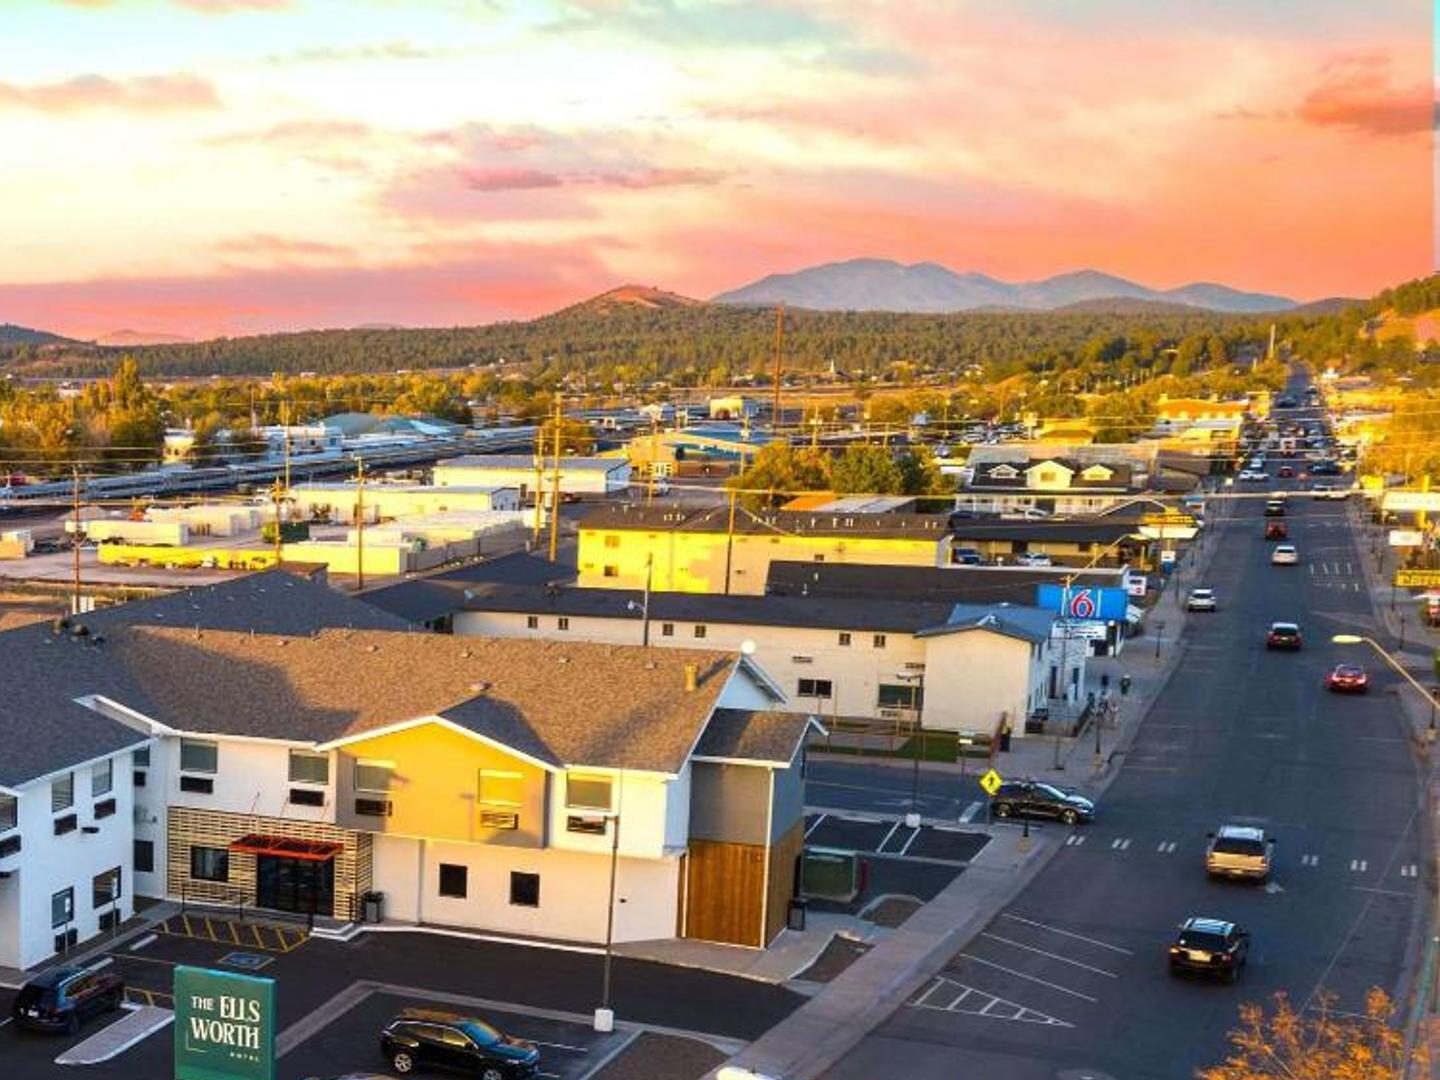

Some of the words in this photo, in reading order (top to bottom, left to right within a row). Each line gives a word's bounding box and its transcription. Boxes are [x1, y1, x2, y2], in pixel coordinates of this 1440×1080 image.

[1071, 589, 1095, 618] 6
[191, 996, 215, 1011] THE
[220, 995, 260, 1023] ELLS
[190, 1017, 260, 1049] WORTH
